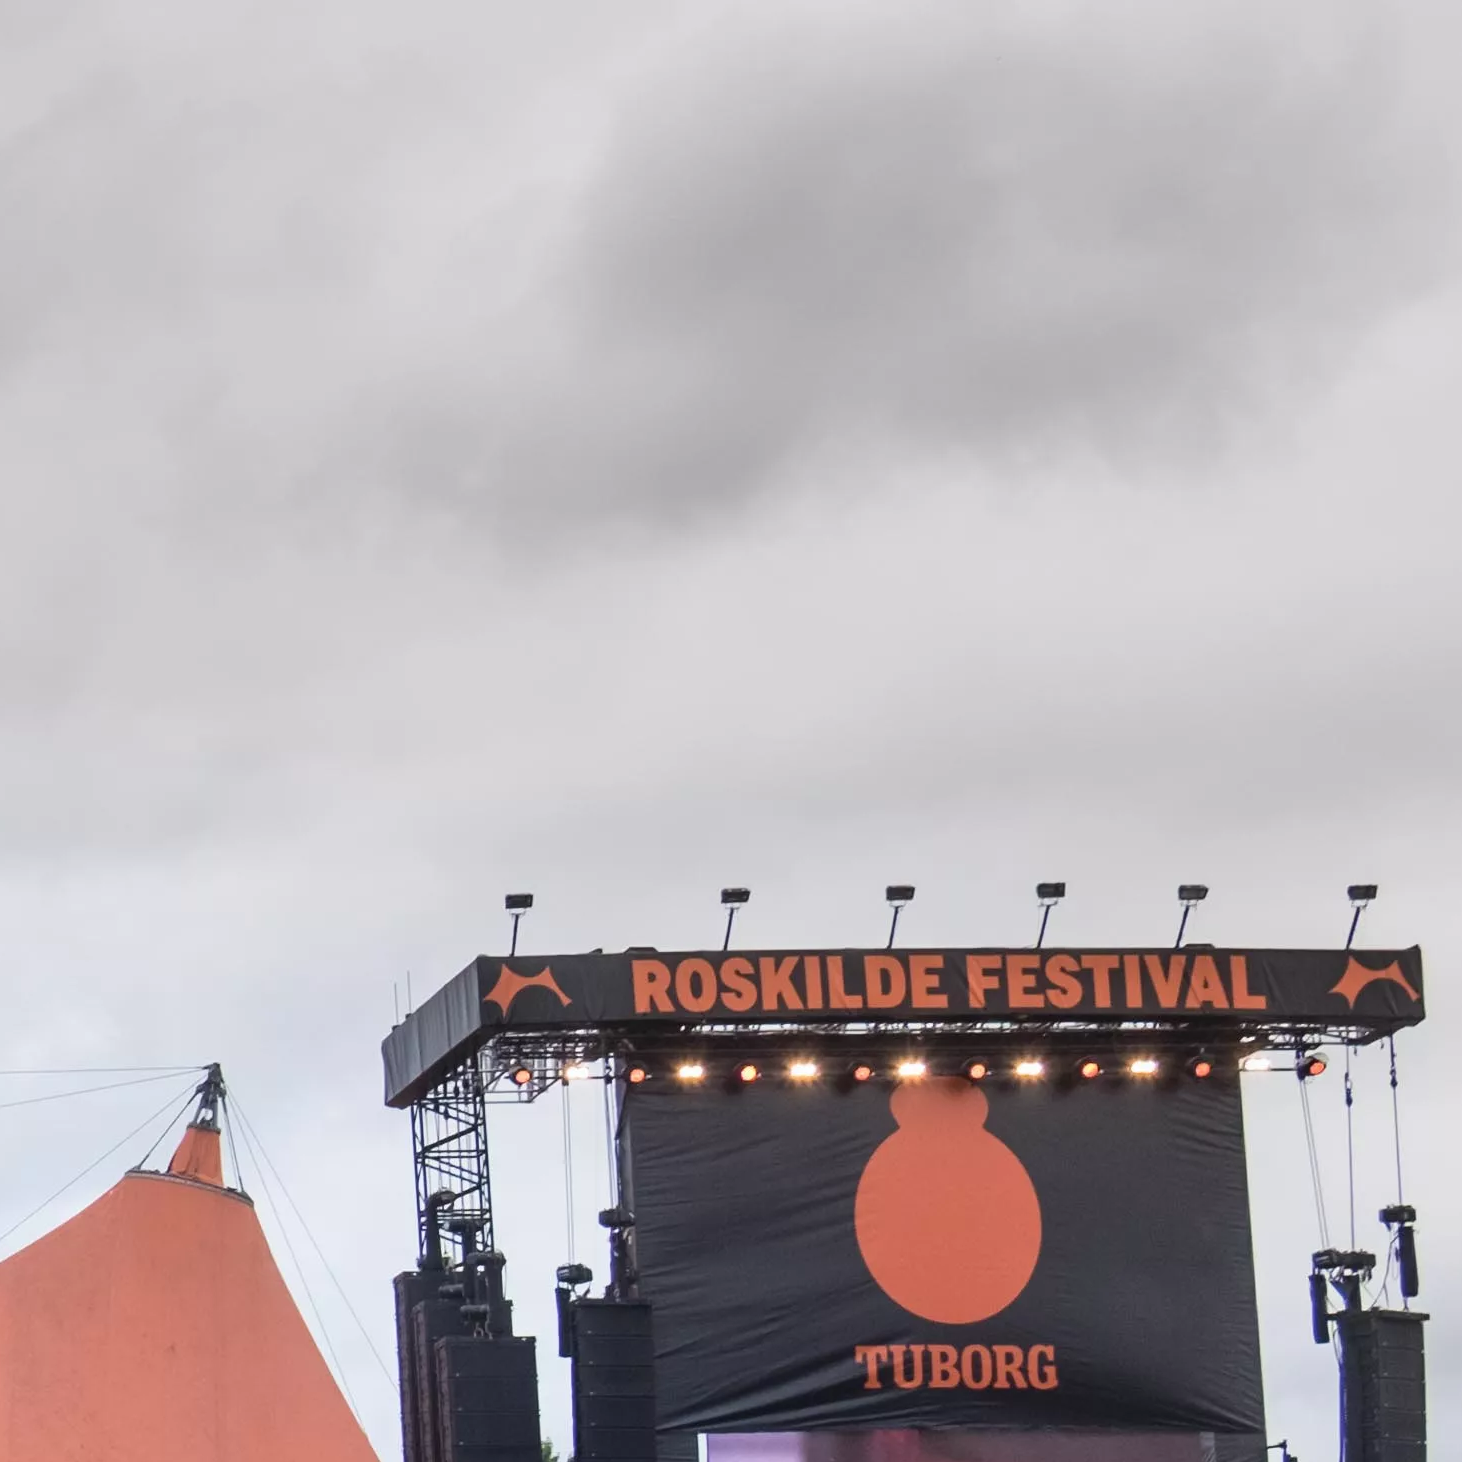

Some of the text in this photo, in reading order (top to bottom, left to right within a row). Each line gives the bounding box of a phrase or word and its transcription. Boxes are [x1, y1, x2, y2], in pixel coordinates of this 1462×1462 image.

[633, 954, 1266, 1013] ROSKILDE FESTIVAL
[855, 1344, 1057, 1390] TUBORG
